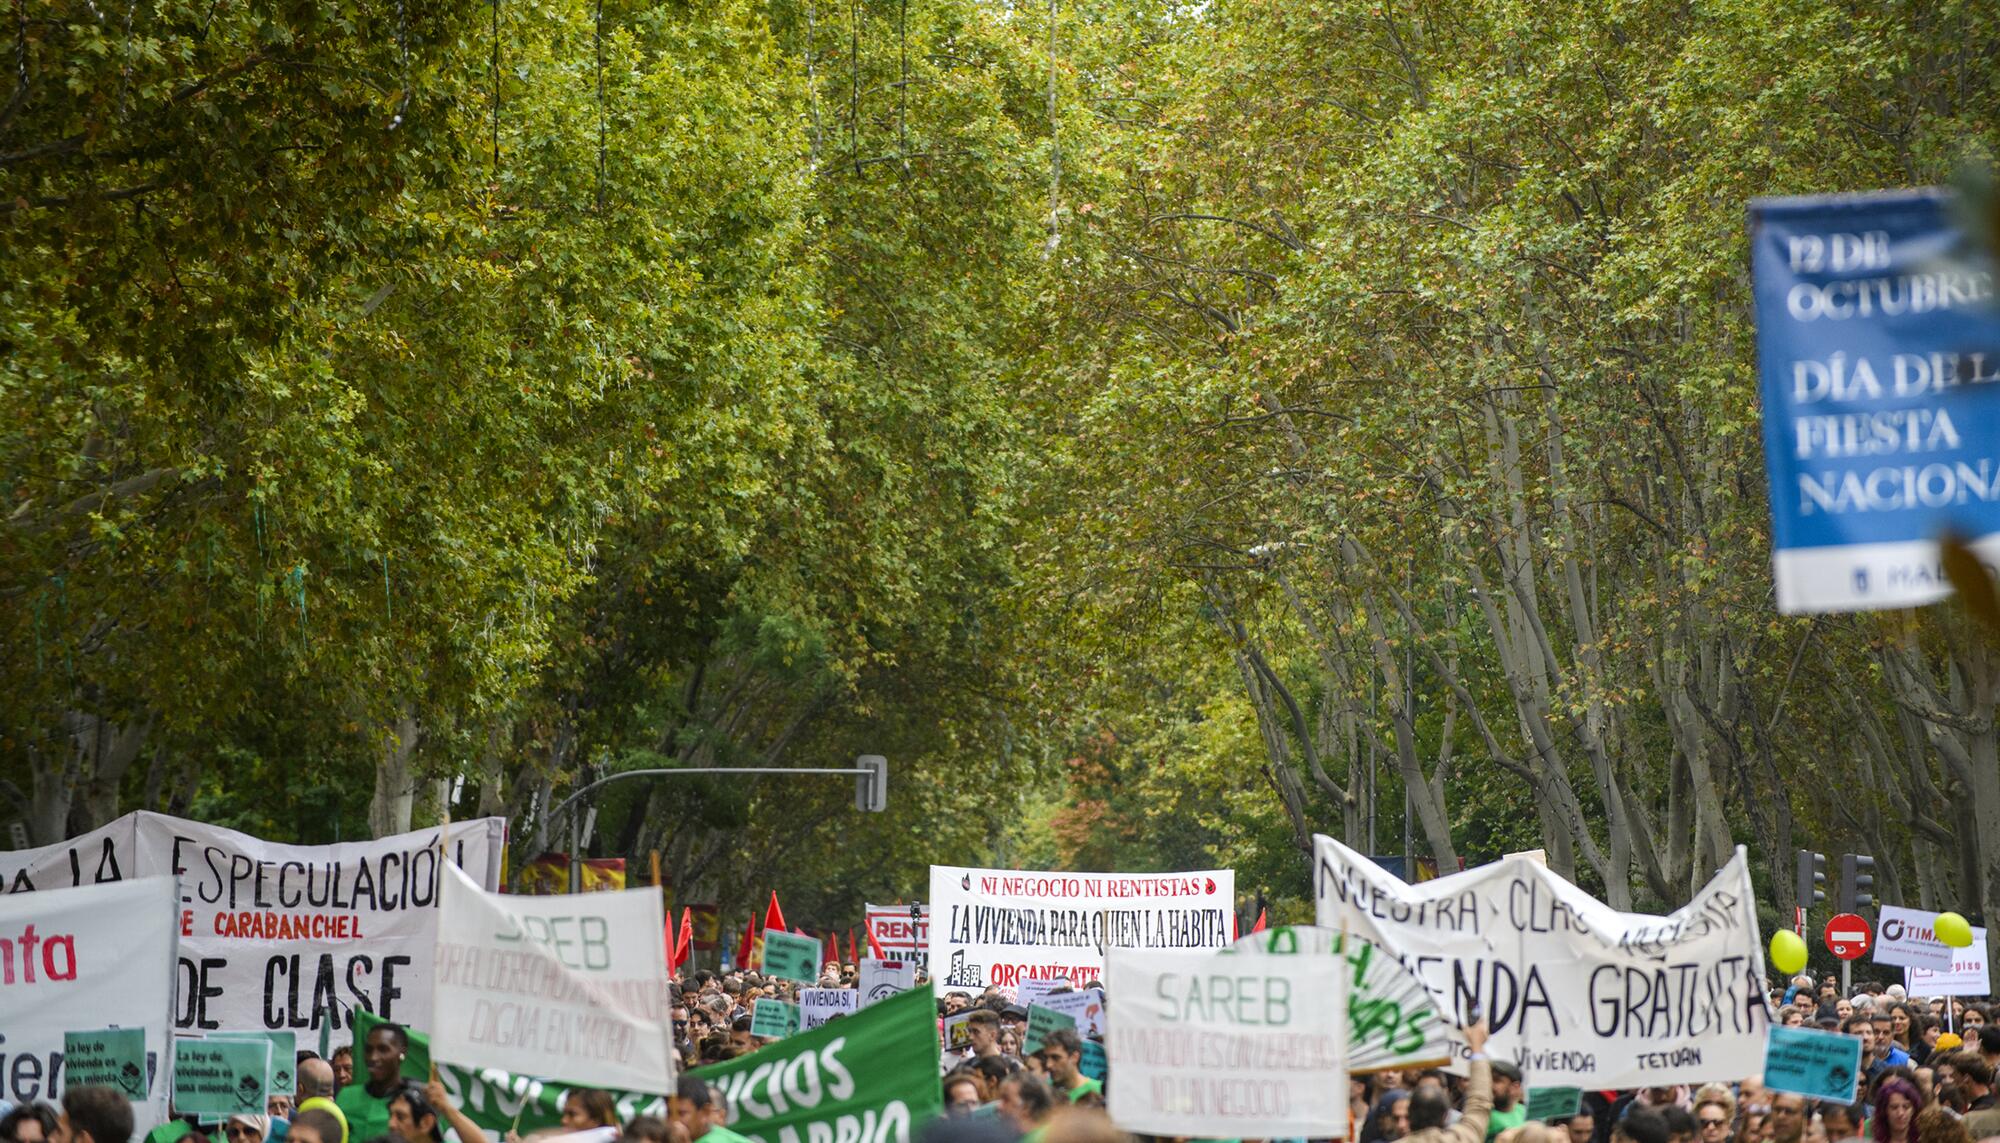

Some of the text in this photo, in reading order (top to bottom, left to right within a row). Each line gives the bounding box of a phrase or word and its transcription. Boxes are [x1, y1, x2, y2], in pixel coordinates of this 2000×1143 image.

[1788, 229, 1892, 274] 12 DE
[1787, 271, 1993, 323] OCTUBRE
[1793, 350, 1883, 404] DÍA
[1892, 352, 1961, 398] DE
[1796, 407, 1961, 461] FIESTA
[980, 877, 1201, 898] NI NEGOCIO NI RENTISTAS
[213, 911, 364, 940] CARABANCHEL
[950, 904, 1227, 957] LA VIVIENDA PARA QUIEN LA HABITA
[174, 952, 412, 1031] DE CLASE
[804, 990, 840, 1007] VIVIENDA
[1156, 972, 1292, 1027] SAREB
[1589, 955, 1773, 1039] GRATUITA
[66, 1041, 105, 1056] La ley de
[177, 1049, 223, 1062] La ley de
[1209, 1077, 1291, 1118] NEGOCIO
